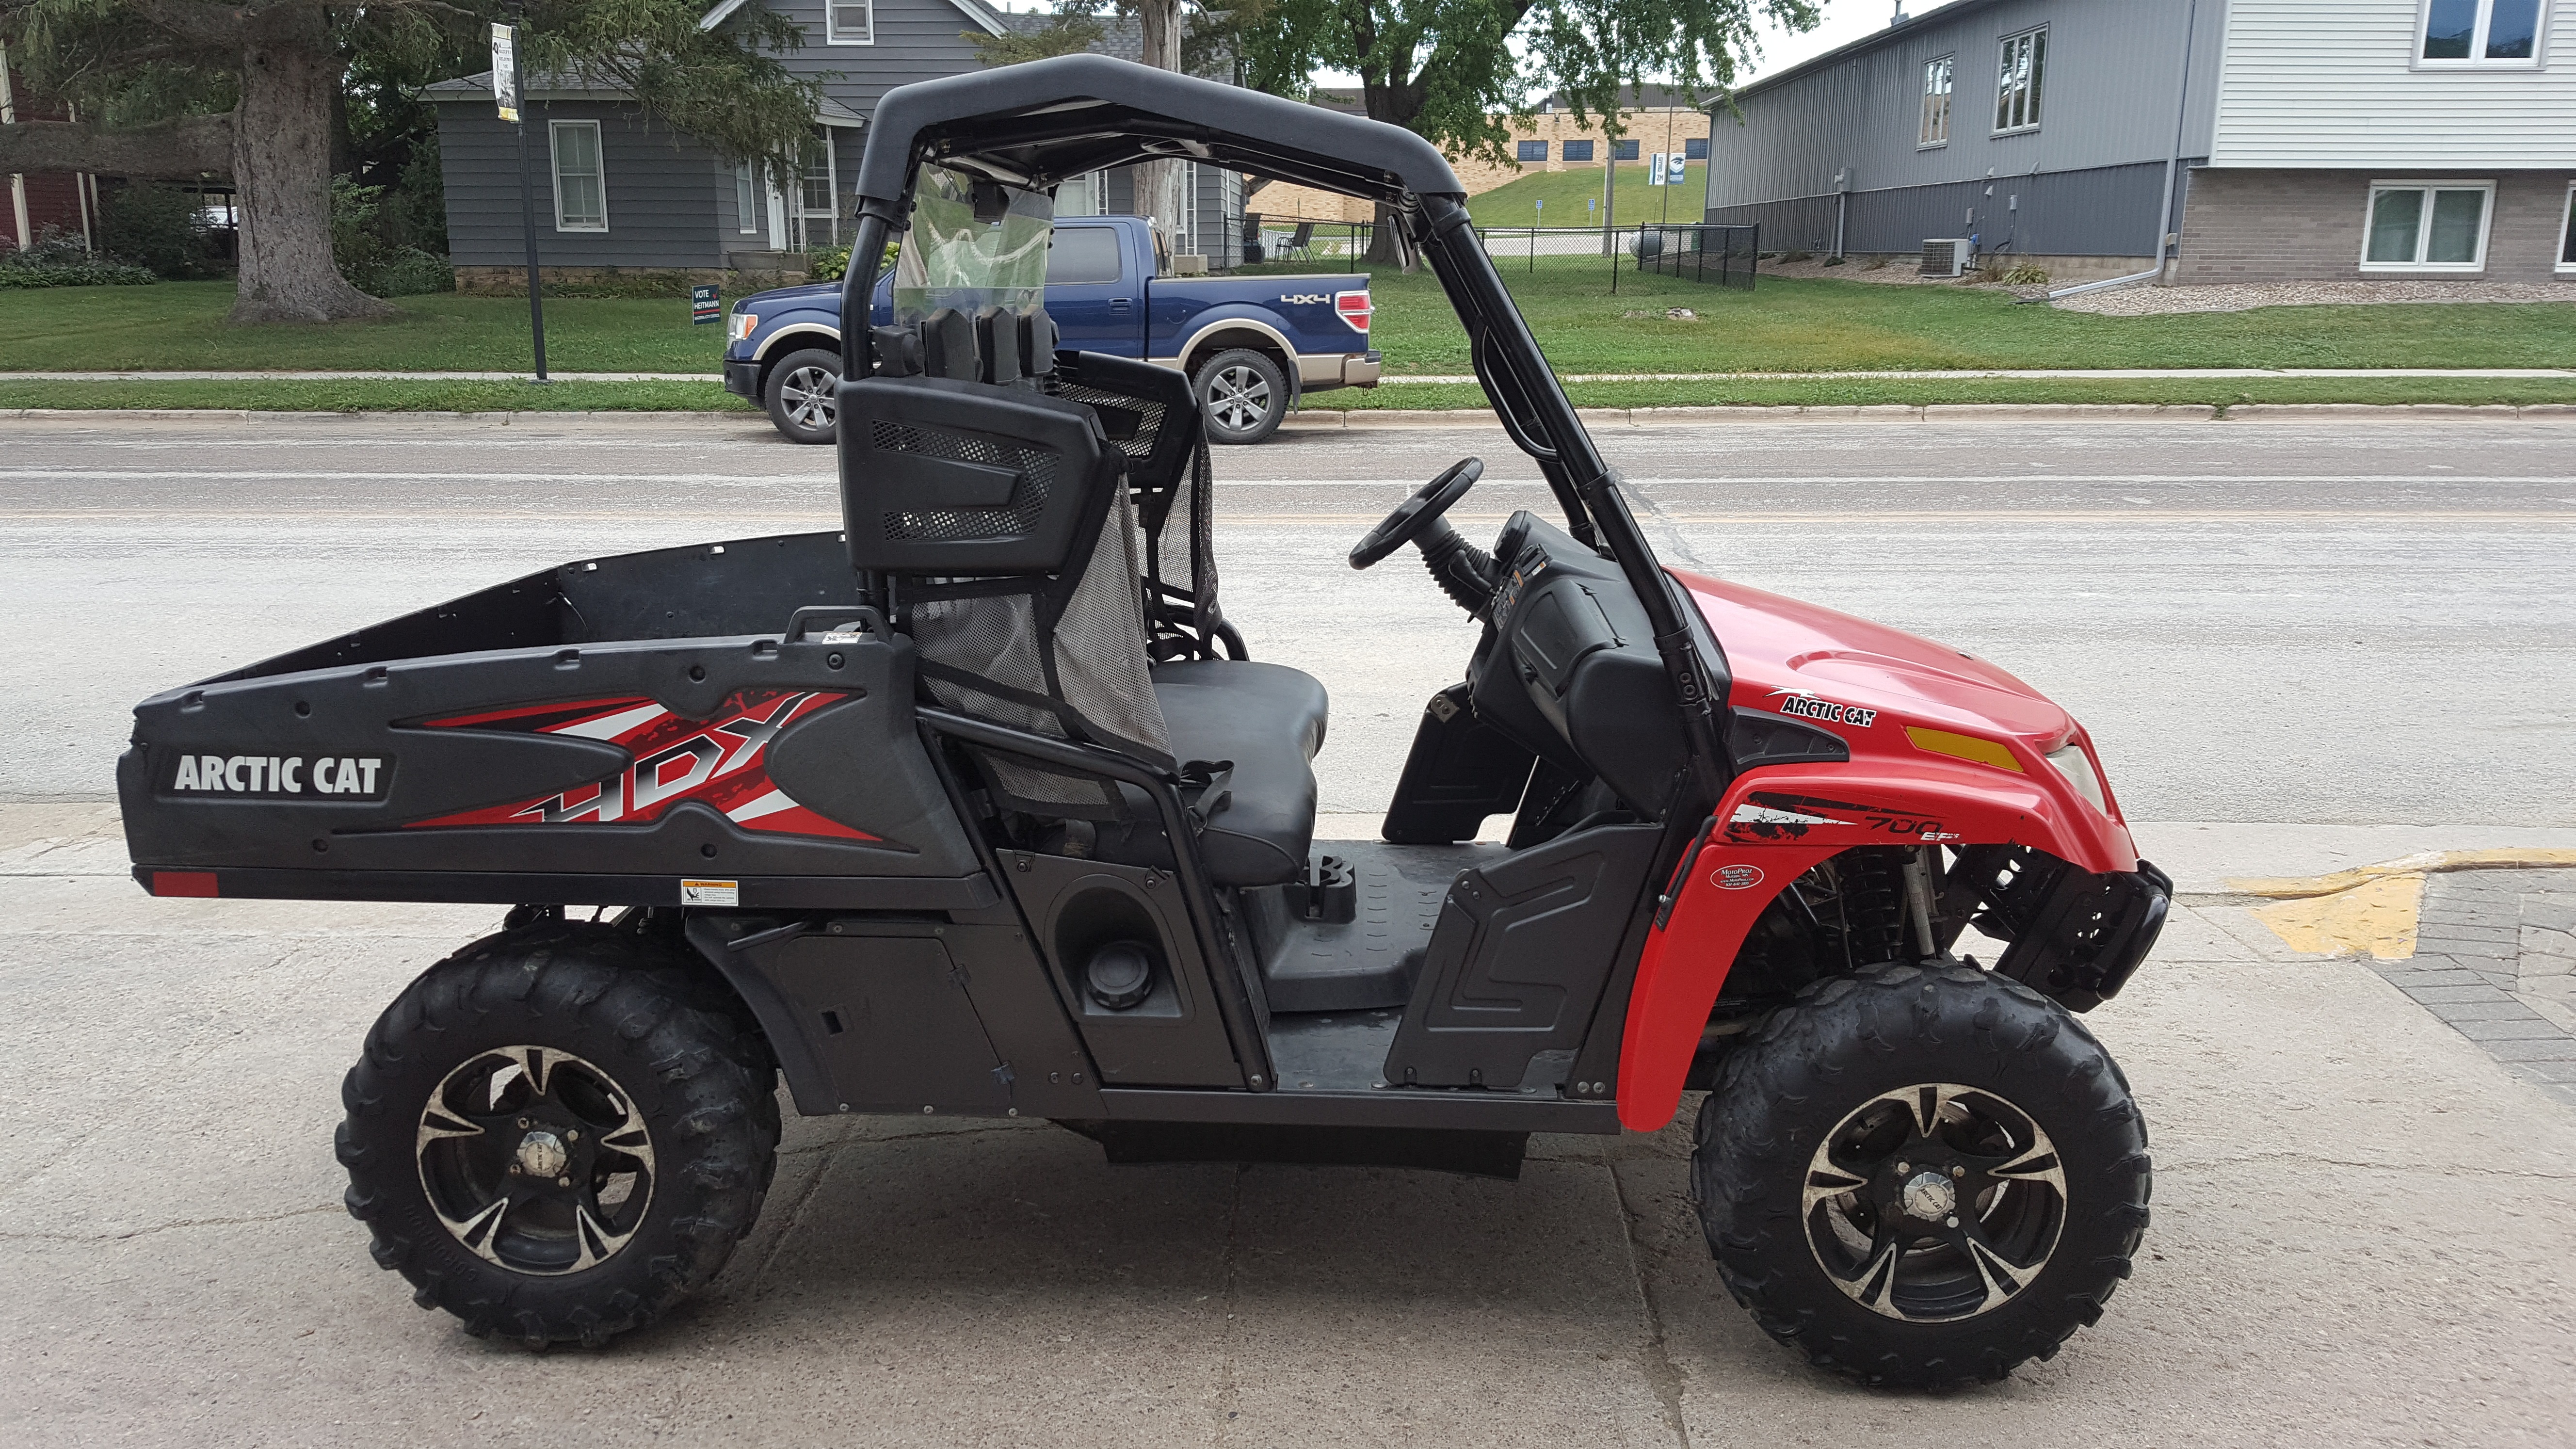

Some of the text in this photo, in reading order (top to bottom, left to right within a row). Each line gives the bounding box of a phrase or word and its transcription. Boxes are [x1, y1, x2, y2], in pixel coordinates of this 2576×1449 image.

[694, 290, 709, 299] VOTE
[694, 300, 719, 309] HEITMANN
[1281, 294, 1330, 304] 4X4
[1780, 695, 1877, 727] ARCTIC CAT
[174, 755, 381, 793] ARCTIC CAT
[1865, 816, 1943, 836] 700
[1920, 1188, 1942, 1210] ARCTIC CAT
